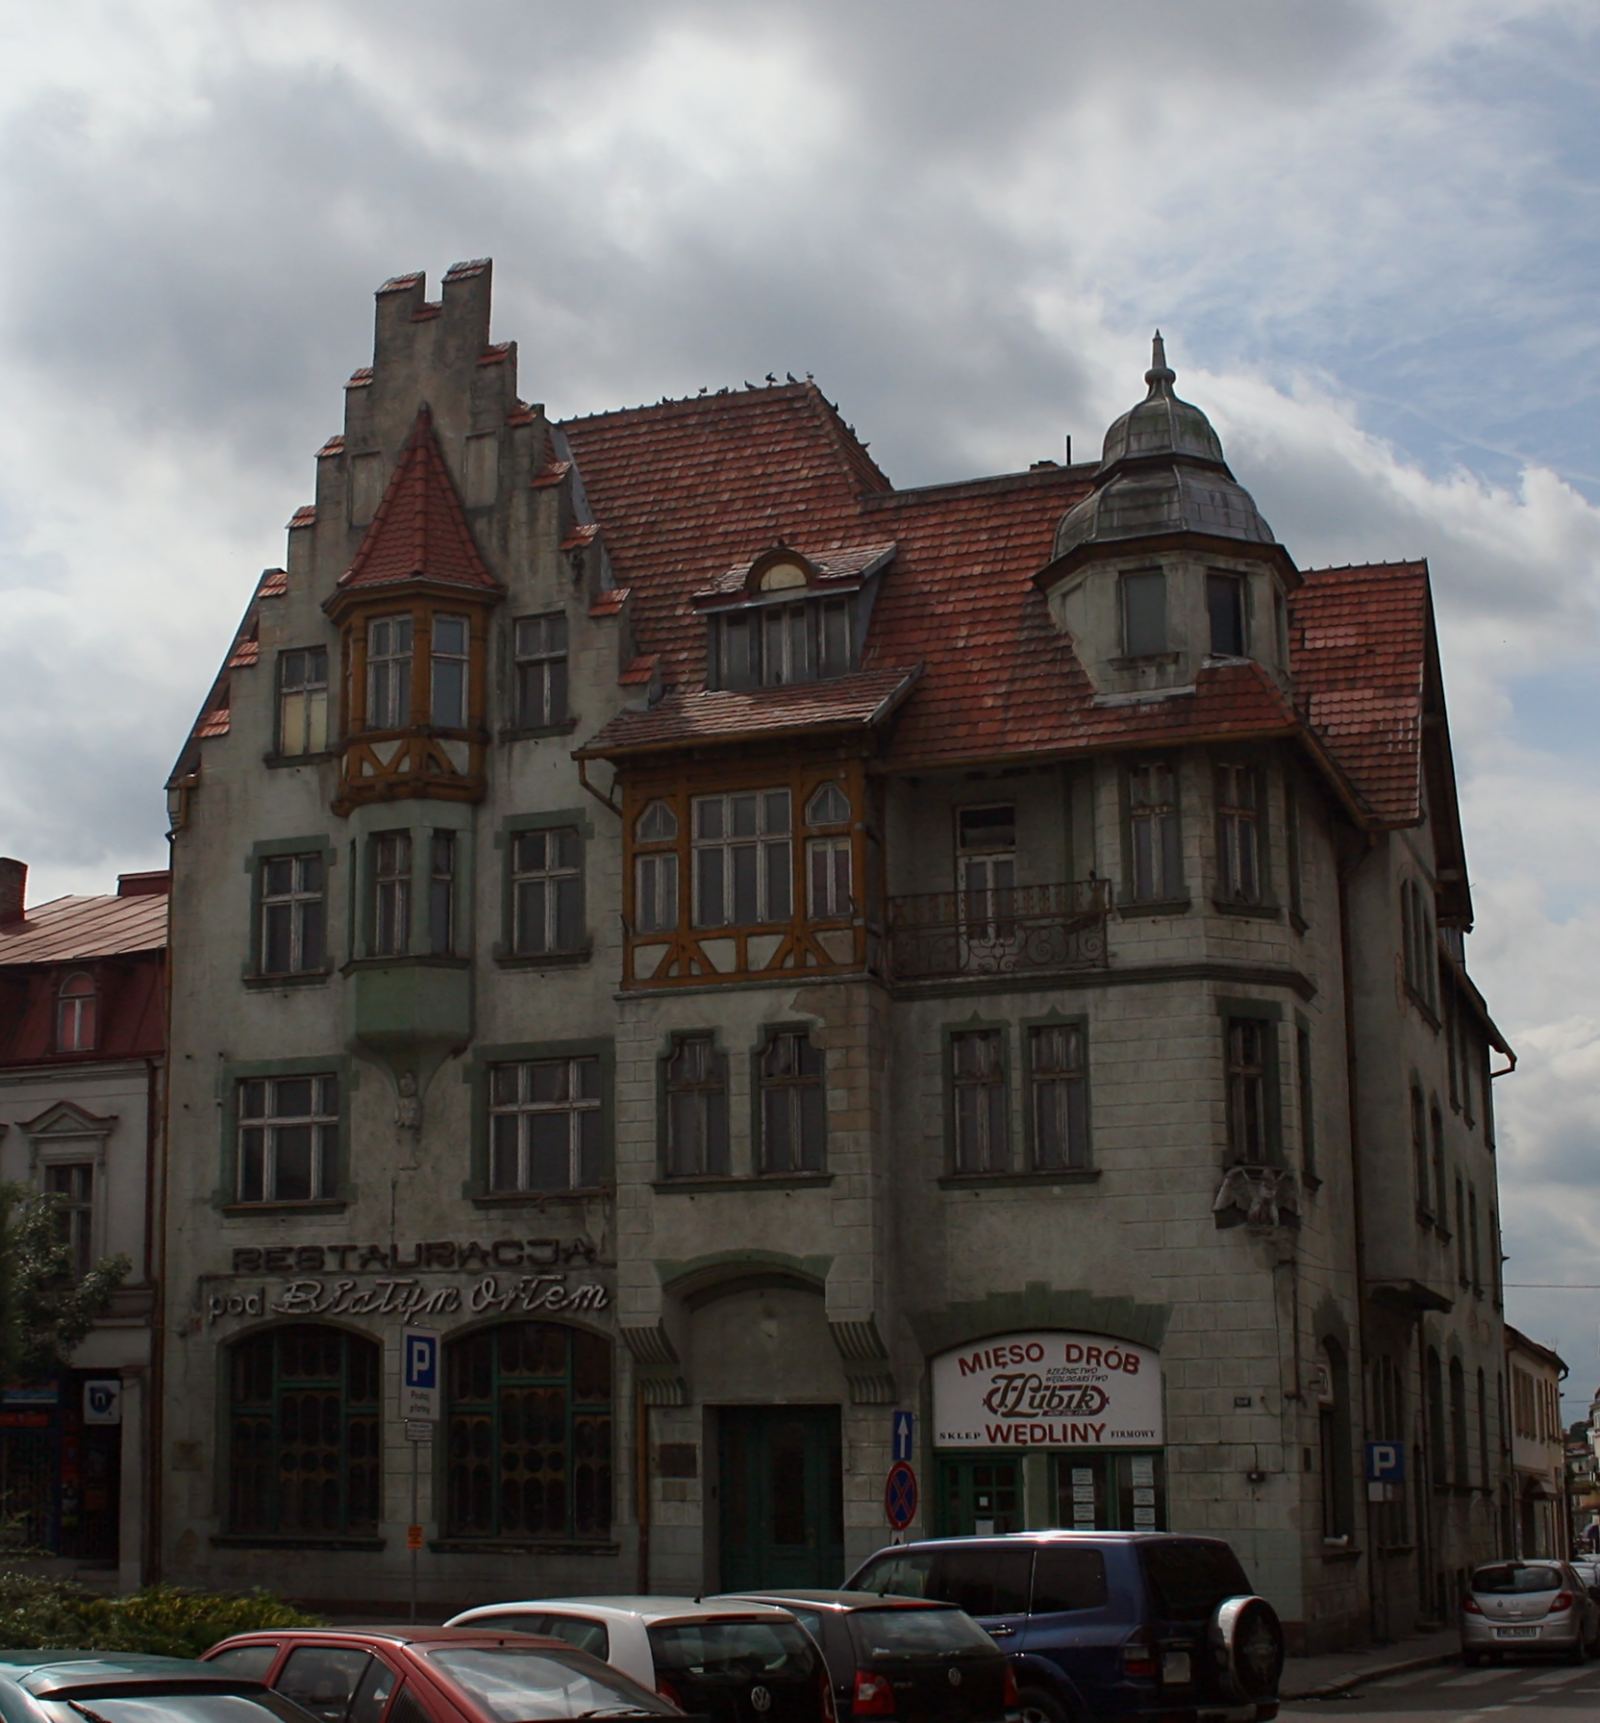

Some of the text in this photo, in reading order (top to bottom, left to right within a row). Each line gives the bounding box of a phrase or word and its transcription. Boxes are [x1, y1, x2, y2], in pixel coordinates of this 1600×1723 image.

[233, 1239, 597, 1272] RESTAURACJA
[208, 1287, 264, 1320] pod
[412, 1341, 431, 1382] P
[958, 1343, 1141, 1377] MIĘSO DRÓB
[939, 1423, 1156, 1445] SKLEP WĘDLINY FIRMOWY
[1373, 1446, 1396, 1477] P
